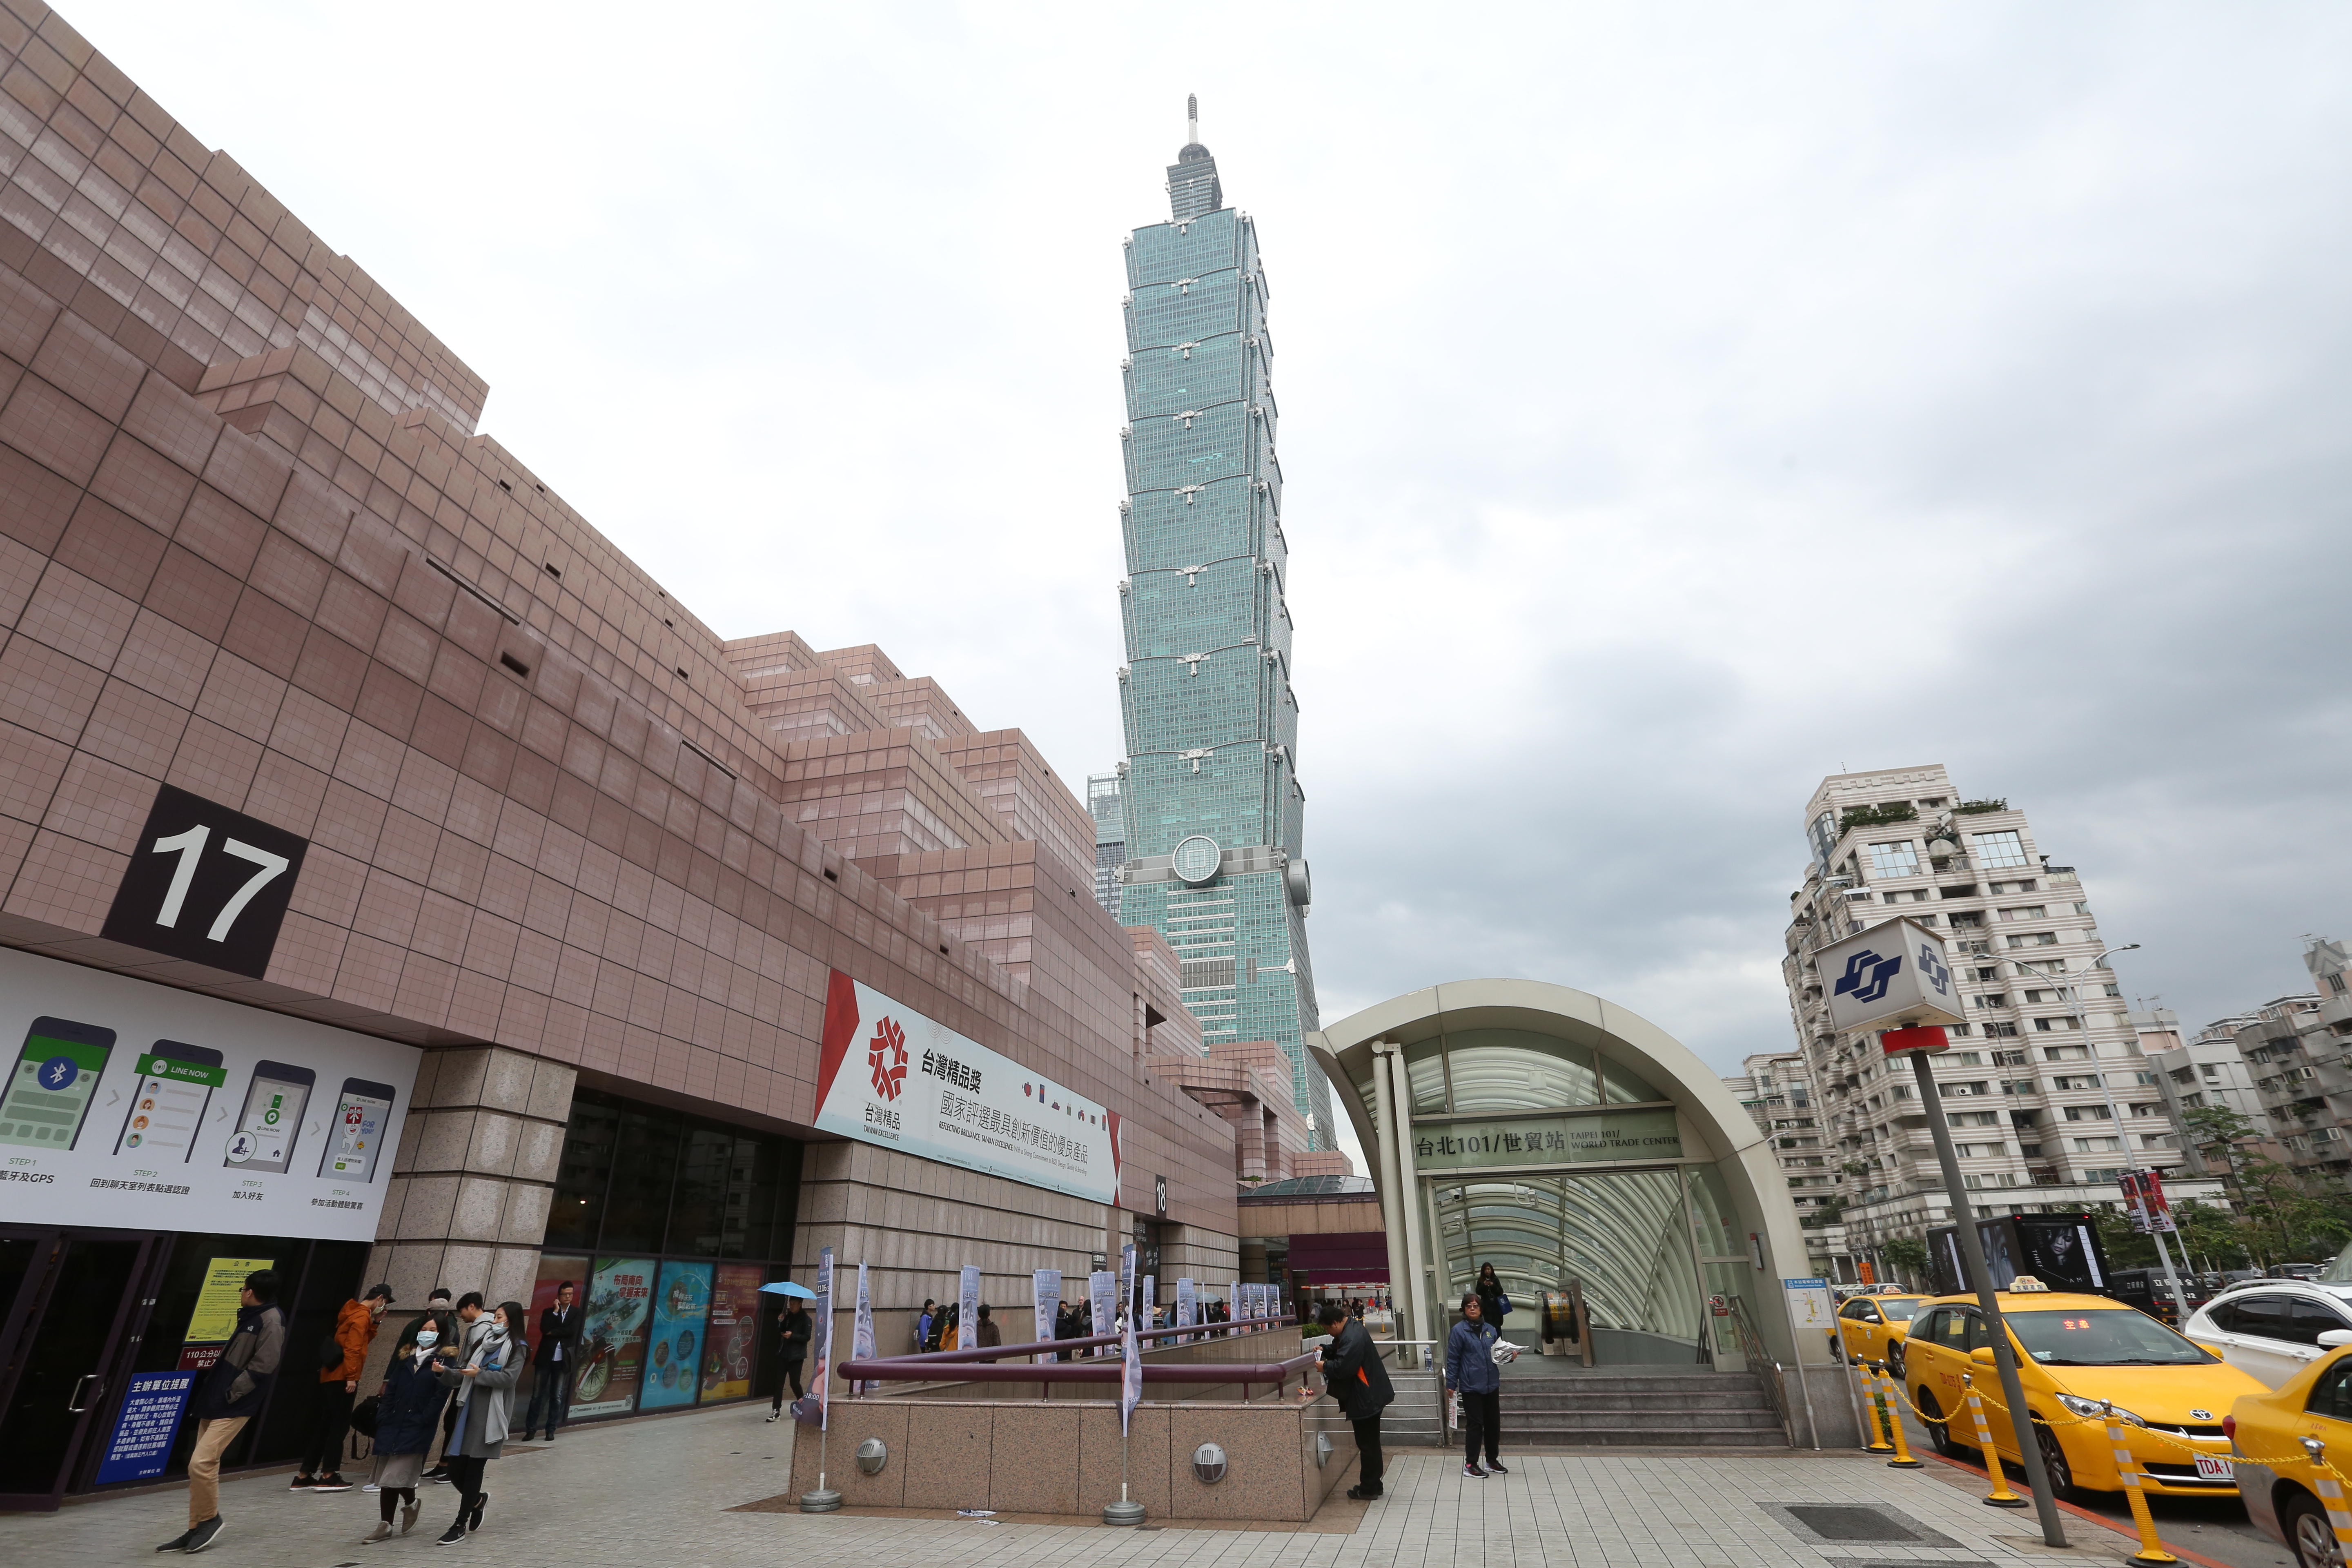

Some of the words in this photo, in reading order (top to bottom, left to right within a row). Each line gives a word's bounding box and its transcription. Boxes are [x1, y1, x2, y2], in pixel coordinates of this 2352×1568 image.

[152, 824, 290, 942] 17
[171, 1067, 188, 1075] LINE
[189, 1070, 209, 1078] NOW
[922, 1048, 982, 1095] 台灣精品獎
[865, 1102, 900, 1131] 台灣精品
[362, 1120, 375, 1128] FOR
[940, 1090, 1088, 1164] 國家評選最具創新價值的優良產品
[864, 1125, 878, 1135] TAIWAN
[878, 1129, 899, 1141] EXCELLENCE
[939, 1121, 960, 1134] REFLECTING
[961, 1128, 980, 1142] BRILLIANCE,
[982, 1135, 995, 1145] TAIWAN
[1601, 1129, 1620, 1138] 101/
[1417, 1131, 1565, 1156] 台北101/世貿站
[1571, 1140, 1606, 1149] WORLD
[1610, 1138, 1640, 1147] TRADE
[1643, 1136, 1679, 1145] CENTER
[9, 1158, 31, 1166] STEP
[90, 1178, 190, 1195] 回到聊天室列表點選認證
[232, 1190, 264, 1201] 加入好友
[1156, 1182, 1166, 1211] 18
[311, 1198, 363, 1210] 參加活動體驗驚喜
[614, 1274, 643, 1286] 布局南向
[618, 1287, 648, 1298] 掌握未來
[2063, 1319, 2090, 1330] 空車
[131, 1378, 190, 1392] 主辦單位提醒
